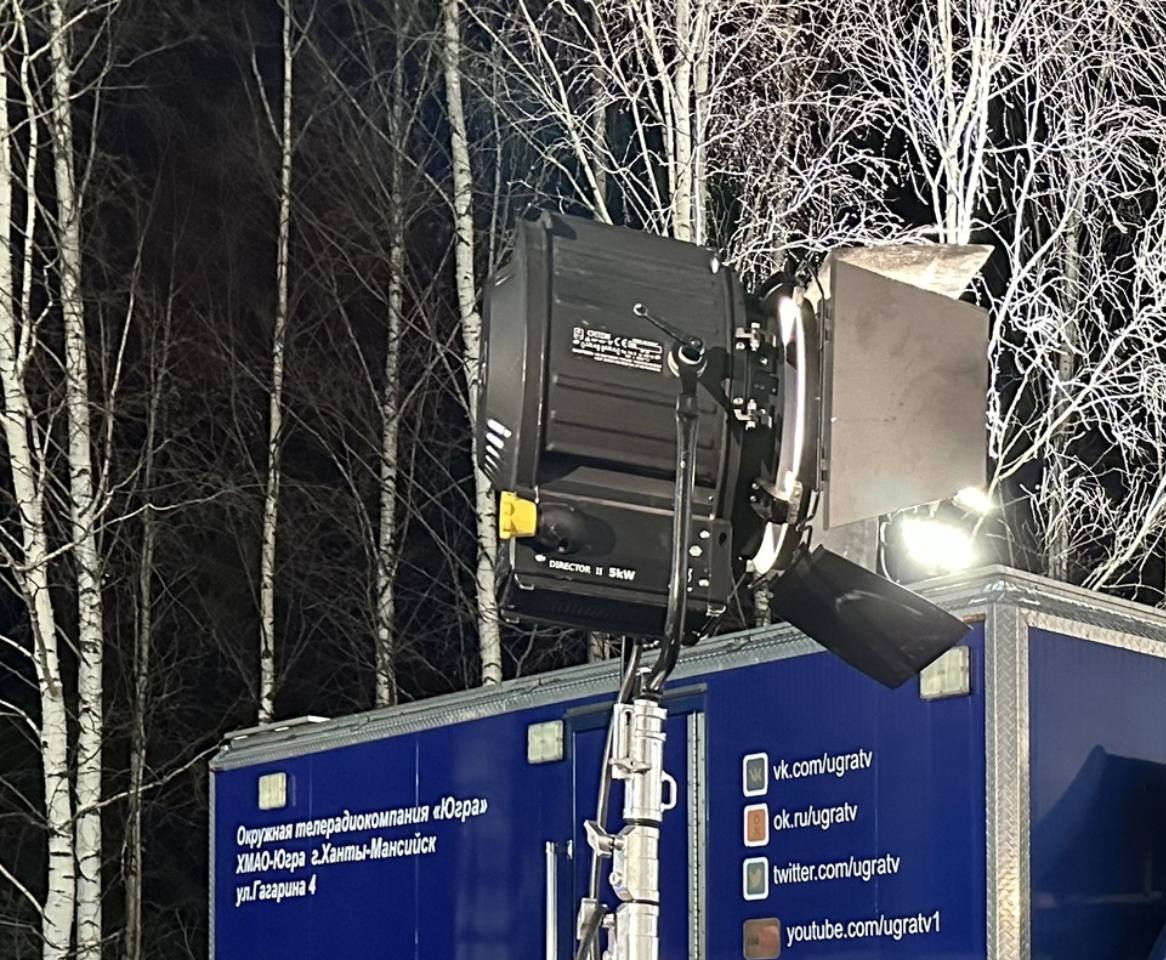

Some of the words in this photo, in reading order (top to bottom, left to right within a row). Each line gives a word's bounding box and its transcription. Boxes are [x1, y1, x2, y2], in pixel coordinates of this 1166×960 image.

[549, 559, 591, 574] DIRECTOR
[608, 568, 636, 581] 5kW
[773, 749, 873, 780] vk.com/ugratv
[237, 825, 294, 849] Окружная
[295, 805, 430, 839] телерадиокомпания
[433, 796, 488, 822] «Югра»
[773, 802, 858, 830] ok.ru/ugratv
[236, 849, 306, 874] ХМАО-Югра
[311, 832, 437, 865] г.Ханты-Мансийск
[773, 853, 901, 884] twitter.com/ugratv
[236, 880, 306, 907] ул.Гагарина
[308, 874, 317, 895] 4
[786, 911, 940, 947] youtube.com/ugratv1
